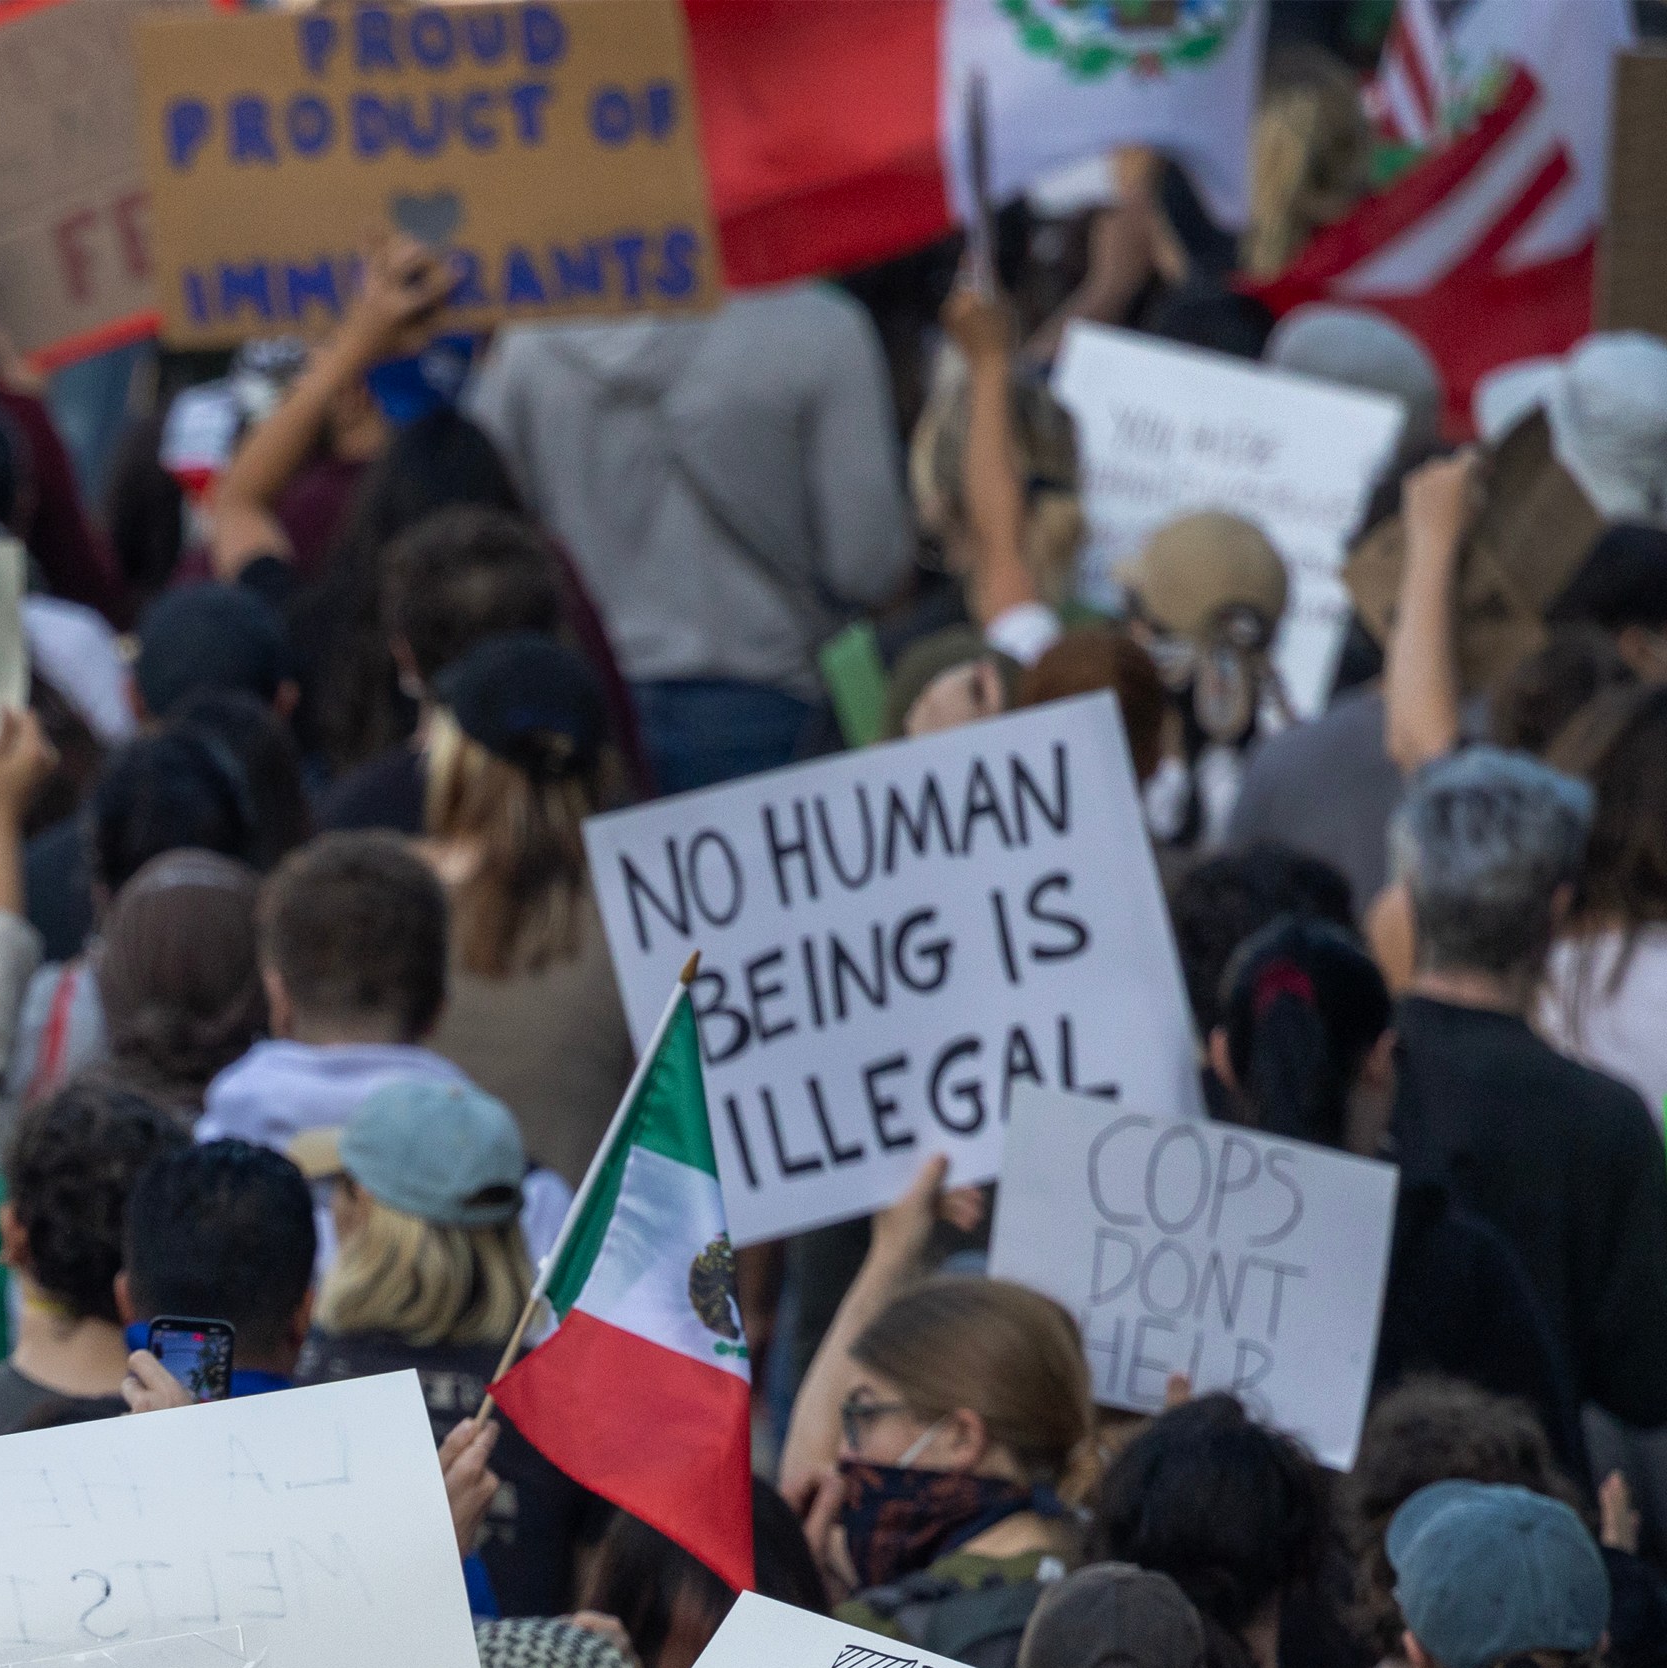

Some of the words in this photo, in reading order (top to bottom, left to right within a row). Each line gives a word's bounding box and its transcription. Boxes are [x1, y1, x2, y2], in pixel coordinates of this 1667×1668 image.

[295, 4, 567, 77] PROUD
[166, 84, 553, 170] PRODUCT
[590, 82, 678, 148] OF
[619, 828, 742, 953] NO
[763, 743, 1069, 906] HUMAN
[689, 908, 952, 1066] BEING
[993, 873, 1091, 984] IS
[723, 1014, 1119, 1190] ILLEGAL
[1087, 1112, 1306, 1248] COPS
[1090, 1227, 1310, 1337] DONT
